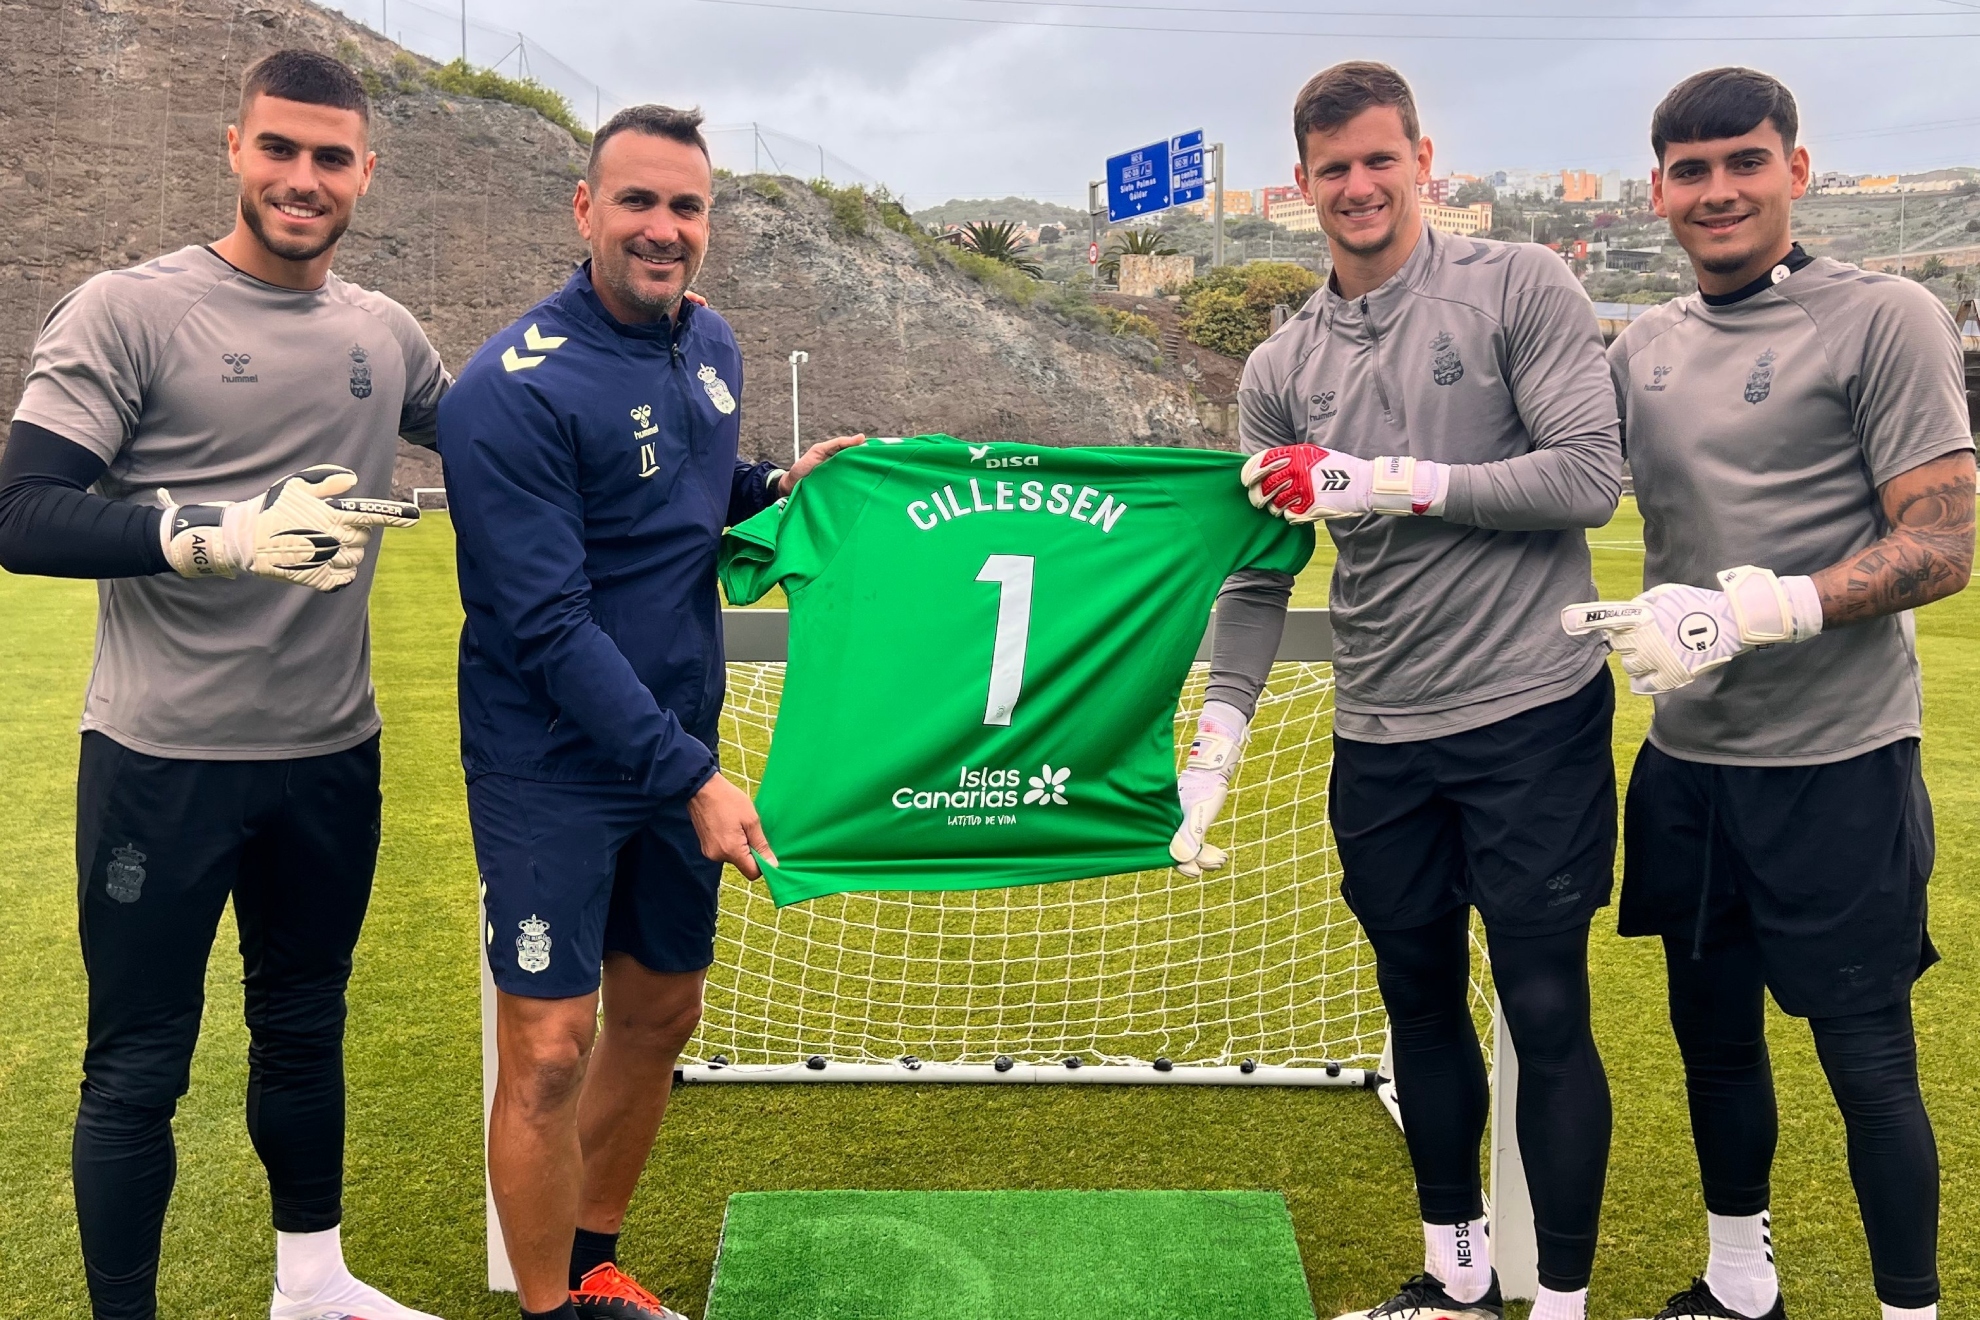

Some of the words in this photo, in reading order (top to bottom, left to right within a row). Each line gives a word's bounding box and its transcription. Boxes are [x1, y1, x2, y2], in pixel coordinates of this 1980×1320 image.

[1136, 177, 1156, 189] Palmas
[222, 374, 258, 383] hummel
[633, 423, 659, 440] hummel
[360, 502, 402, 516] SOCCER
[906, 477, 1128, 534] CILLESSEN
[192, 534, 209, 565] AKG
[974, 554, 1035, 727] 1
[958, 765, 1021, 788] Islas
[891, 786, 1018, 809] Canarias
[947, 814, 982, 827] LATITUD
[985, 816, 995, 825] DE
[997, 814, 1017, 825] VIDA
[1456, 1240, 1473, 1268] NEO
